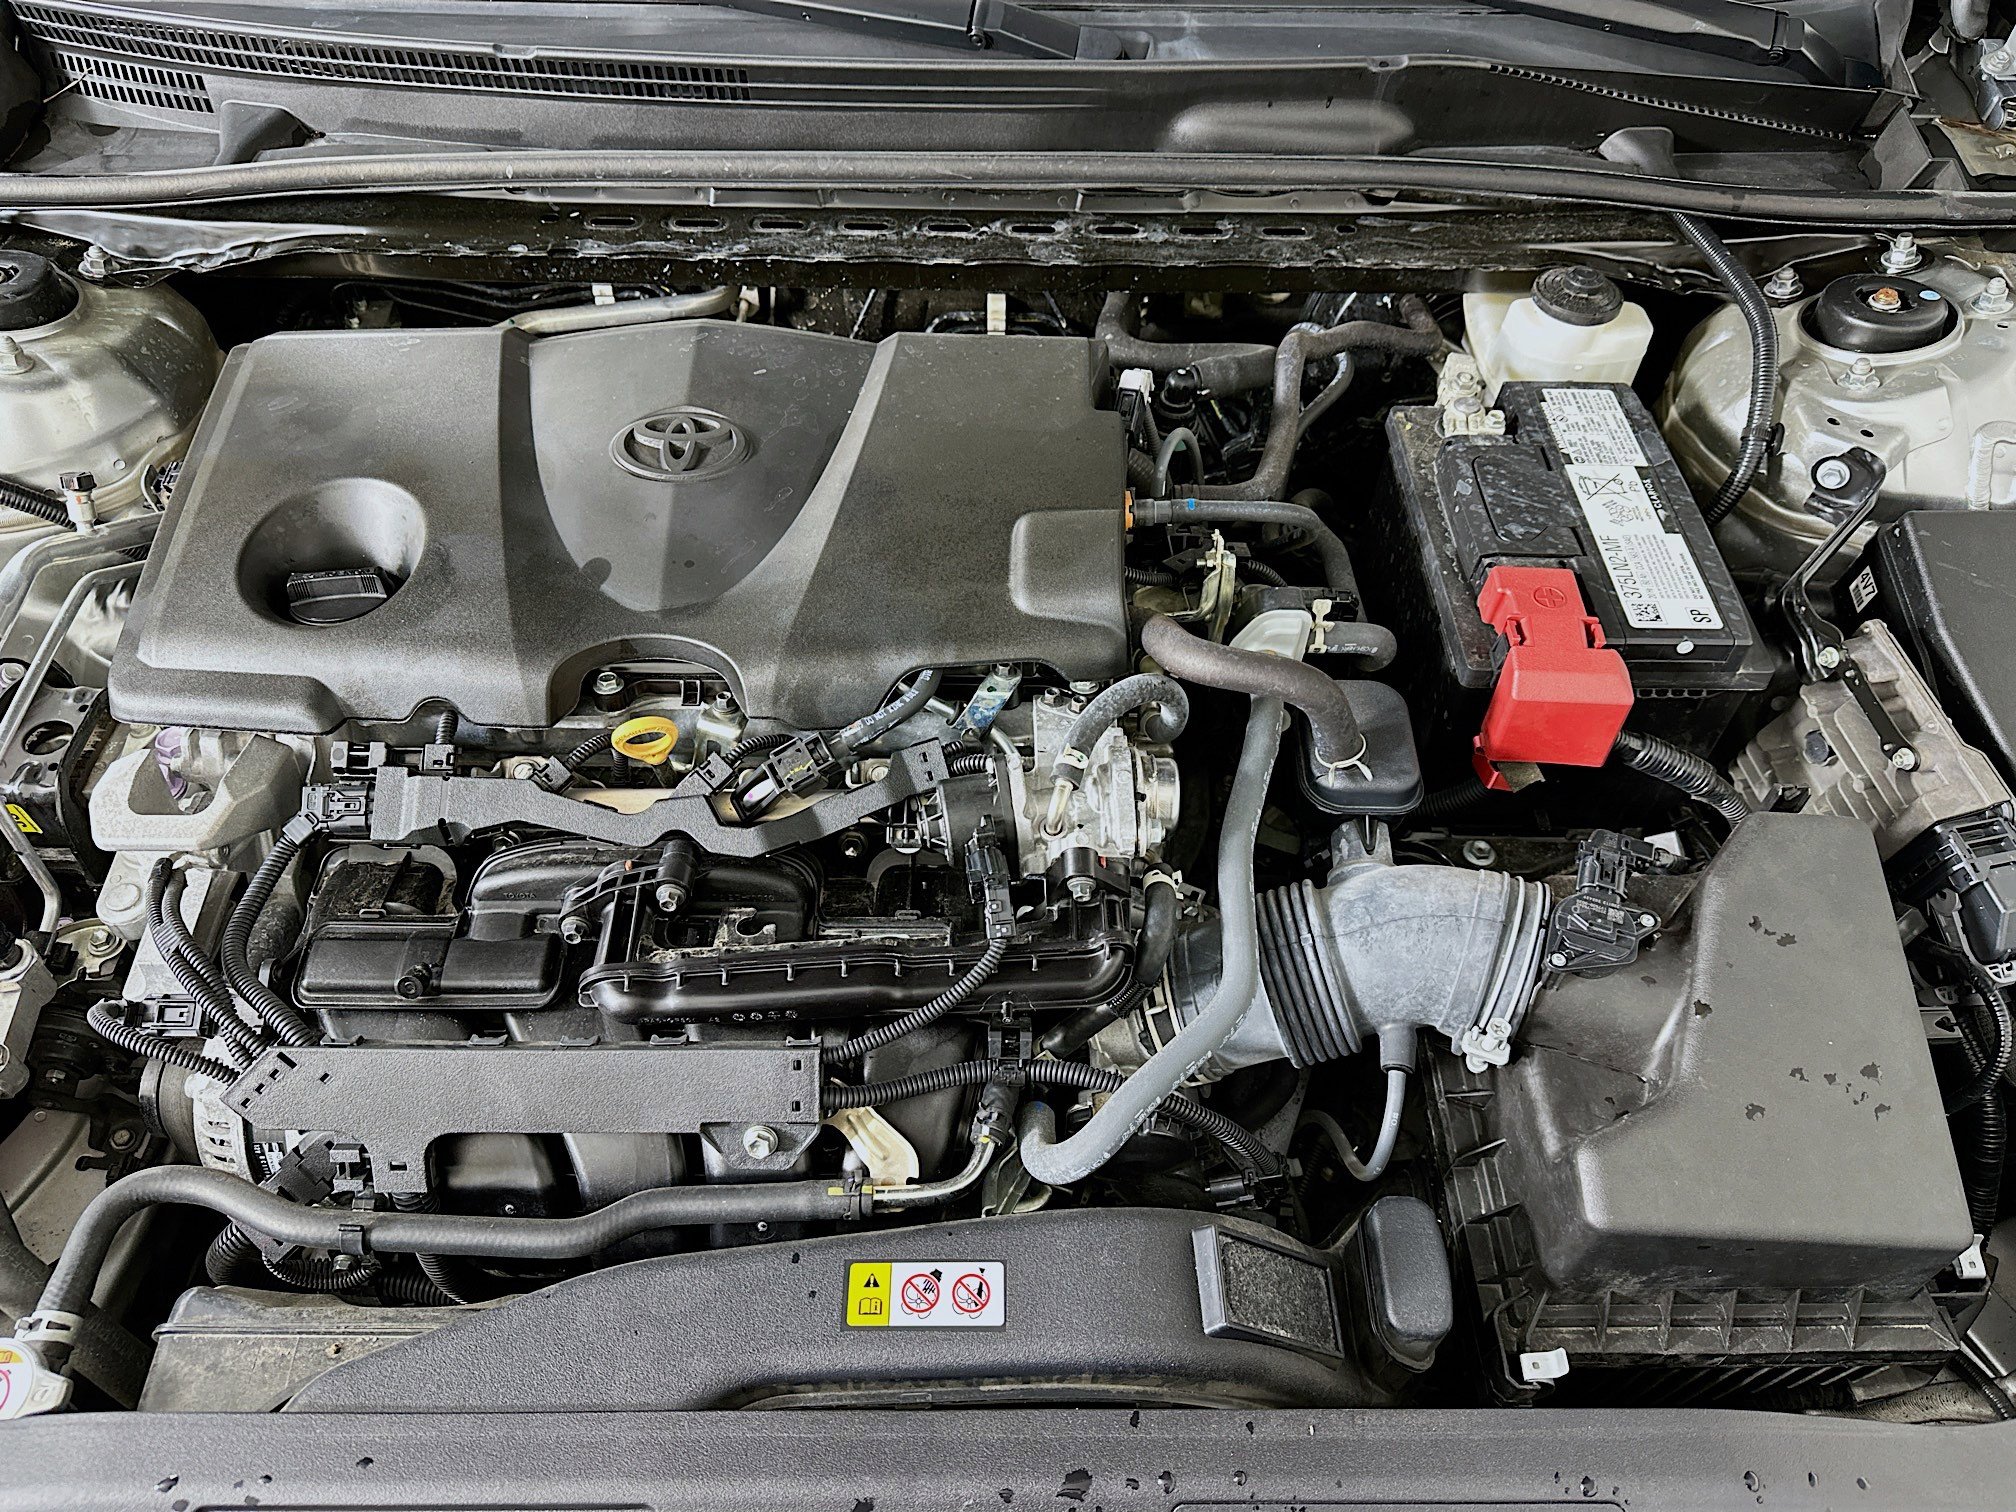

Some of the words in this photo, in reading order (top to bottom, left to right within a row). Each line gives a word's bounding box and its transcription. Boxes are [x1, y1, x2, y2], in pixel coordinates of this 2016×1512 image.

[1642, 479, 1662, 508] CLARIOS
[1599, 535, 1642, 599] 375LN2-MF
[1861, 572, 1875, 597] 4V7
[1690, 609, 1712, 623] SP
[502, 891, 537, 899] TOYOTA
